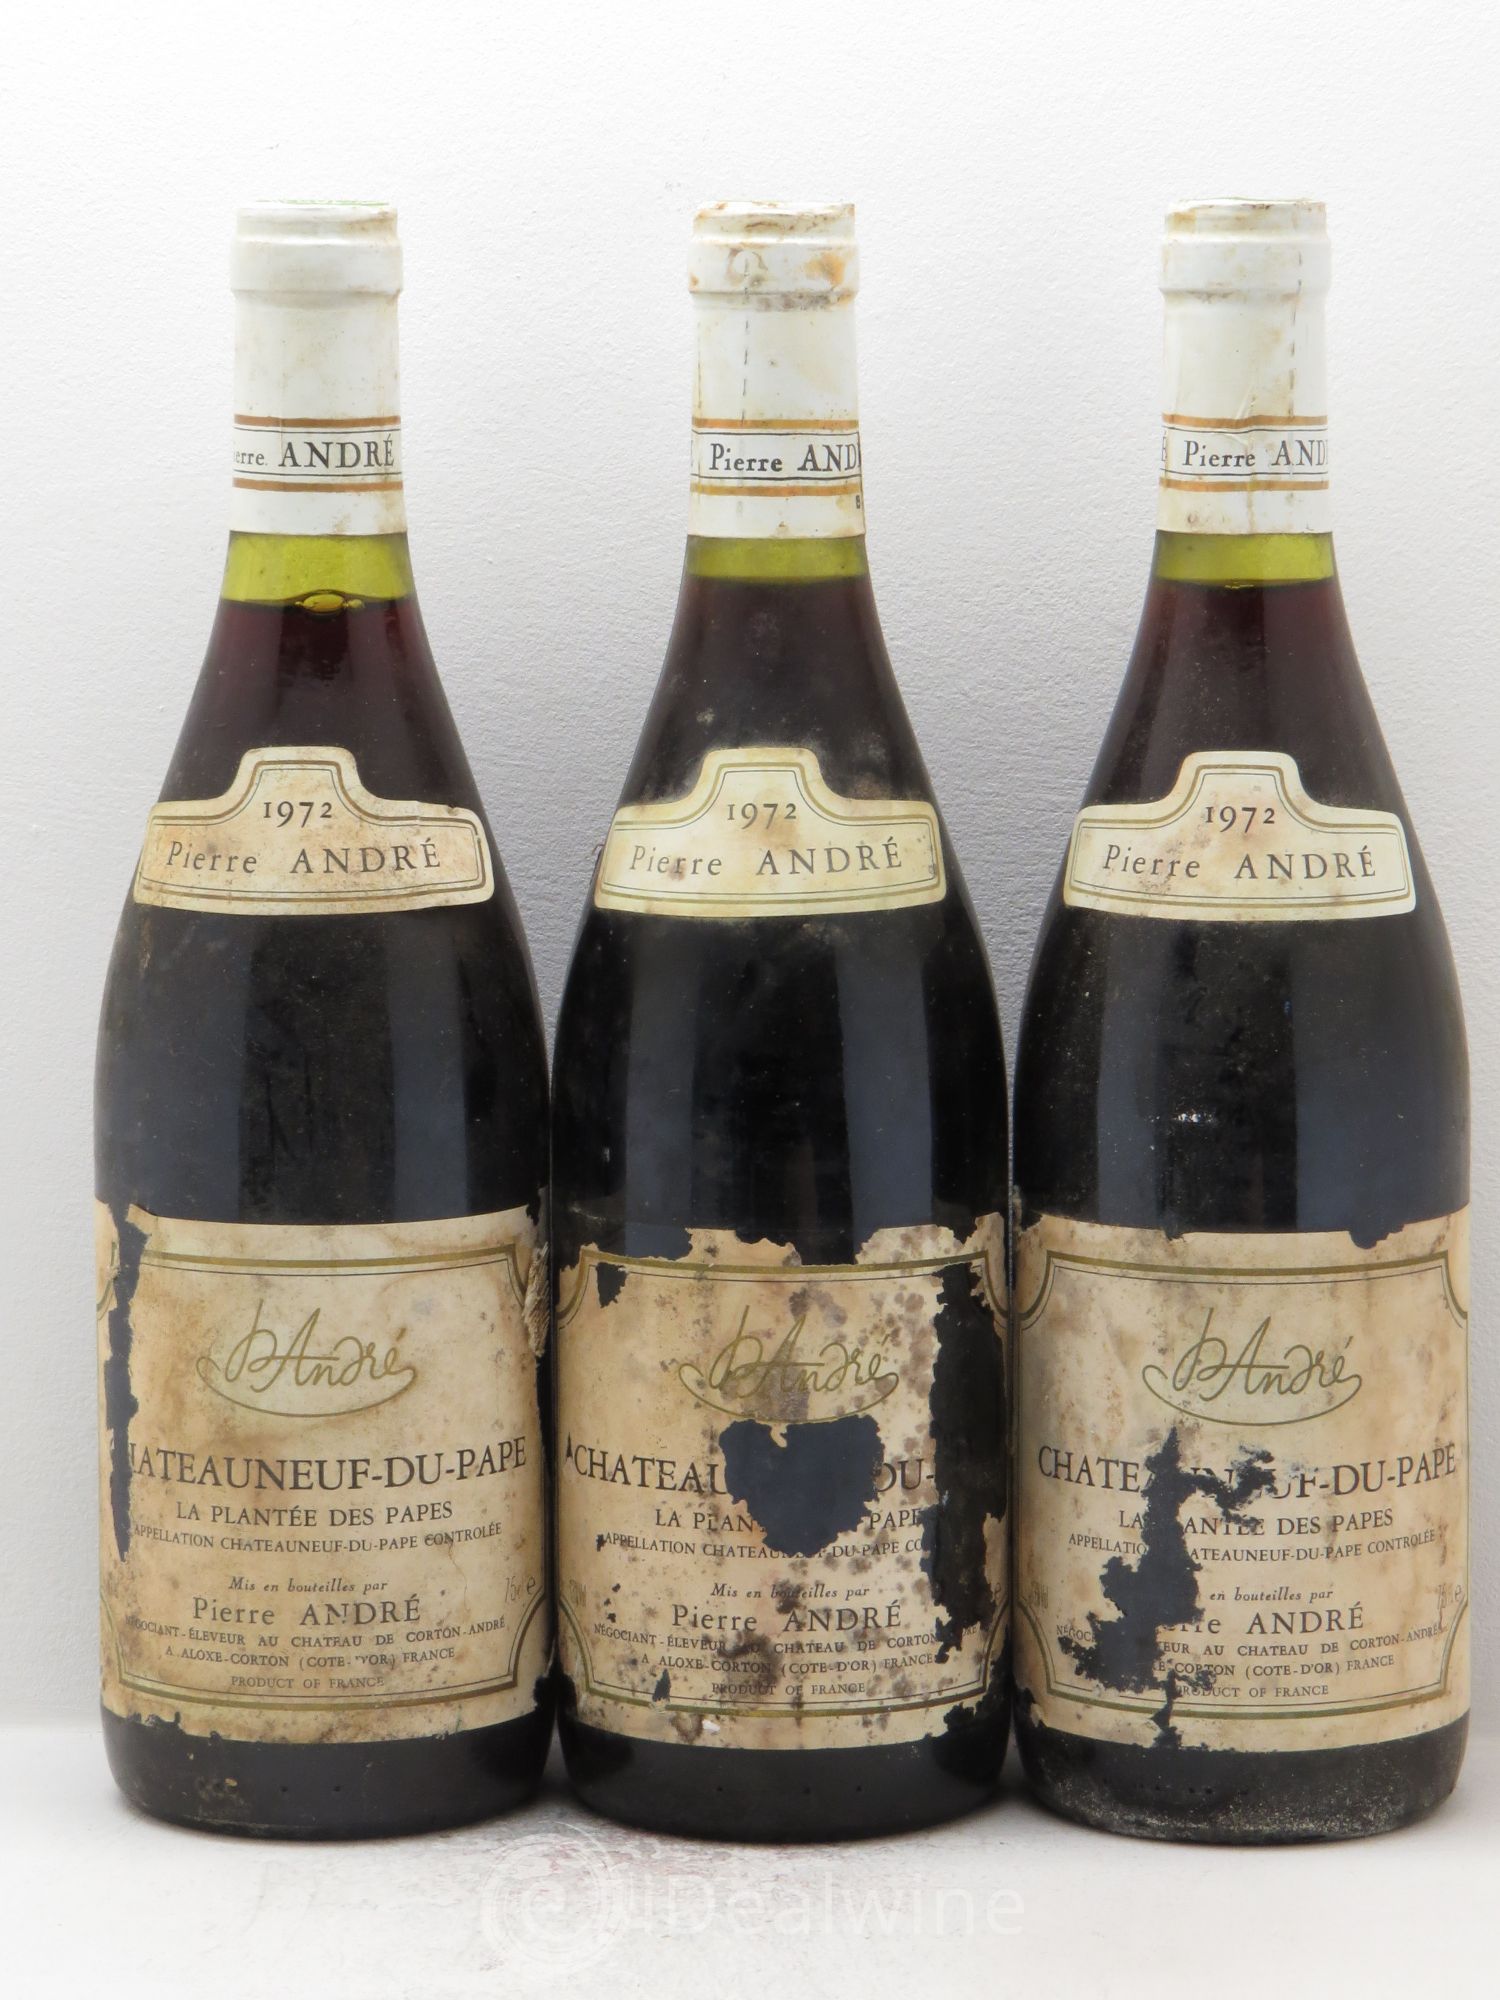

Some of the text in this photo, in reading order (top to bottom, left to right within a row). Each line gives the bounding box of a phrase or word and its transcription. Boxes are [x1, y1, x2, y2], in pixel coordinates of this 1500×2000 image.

[278, 434, 395, 469] ANDRÉ
[709, 443, 862, 472] Pierre AND
[1182, 440, 1256, 468] Pierre
[1271, 440, 1328, 467] AND
[262, 801, 333, 828] 1972
[727, 803, 797, 830] 1972
[1204, 806, 1275, 833] 1972
[166, 838, 441, 874] Pierre ANDRÉ
[629, 836, 902, 876] Pierre ANDRÉ
[1102, 844, 1376, 880] Pierre ANDRÉ
[129, 1435, 527, 1491] ATEAUNEUF-DU-PAPE
[176, 1501, 453, 1527] LA PLANTÉE DES PAPES
[655, 1509, 767, 1533] LA PLAN
[1119, 1511, 1145, 1528] LA
[1278, 1517, 1321, 1536] DES
[1332, 1508, 1394, 1533] PAPES
[133, 1521, 502, 1554] APPELLATION CHATEAUNEUF-DU-PAPE CONTROLÉE
[605, 1532, 696, 1555] APPELLATION
[1069, 1528, 1436, 1563] APPELLATIO ATEAUNEUF-DU-PAPE CONTROLÉE
[227, 1575, 388, 1595] Mis en bouteilles par
[710, 1583, 738, 1597] Mis
[746, 1590, 762, 1599] en
[845, 1587, 870, 1601] par
[1210, 1587, 1334, 1604] en bouteilles par
[192, 1593, 421, 1626] Pierre ANDRÉ
[671, 1600, 901, 1632] Pierre ANDRÉ
[1246, 1601, 1364, 1635] ANDRÉ
[257, 1636, 279, 1647] AU
[291, 1635, 362, 1648] CHATEAU
[376, 1634, 394, 1647] DE
[406, 1616, 506, 1643] CORTON-ANDRÉ
[181, 1647, 290, 1668] ALOXE-CORTON
[403, 1648, 456, 1663] FRANCE
[774, 1641, 846, 1654] CHATEAU
[858, 1640, 876, 1652] DE
[1204, 1645, 1225, 1656] AU
[1237, 1645, 1308, 1657] CHATEAU
[1321, 1643, 1339, 1655] DE
[659, 1656, 772, 1674] ALOXE-CORTON
[781, 1661, 877, 1678] (COTE-D'OR)
[884, 1654, 934, 1670] FRANCE
[1245, 1663, 1340, 1680] (COTE-D'OR)
[1347, 1655, 1395, 1671] FRANCE
[231, 1675, 385, 1689] PRODUCT OF FRANCE
[712, 1682, 866, 1696] PRODUCT OF FRANCE
[1249, 1688, 1267, 1698] OF
[1275, 1685, 1329, 1697] FRANCE
